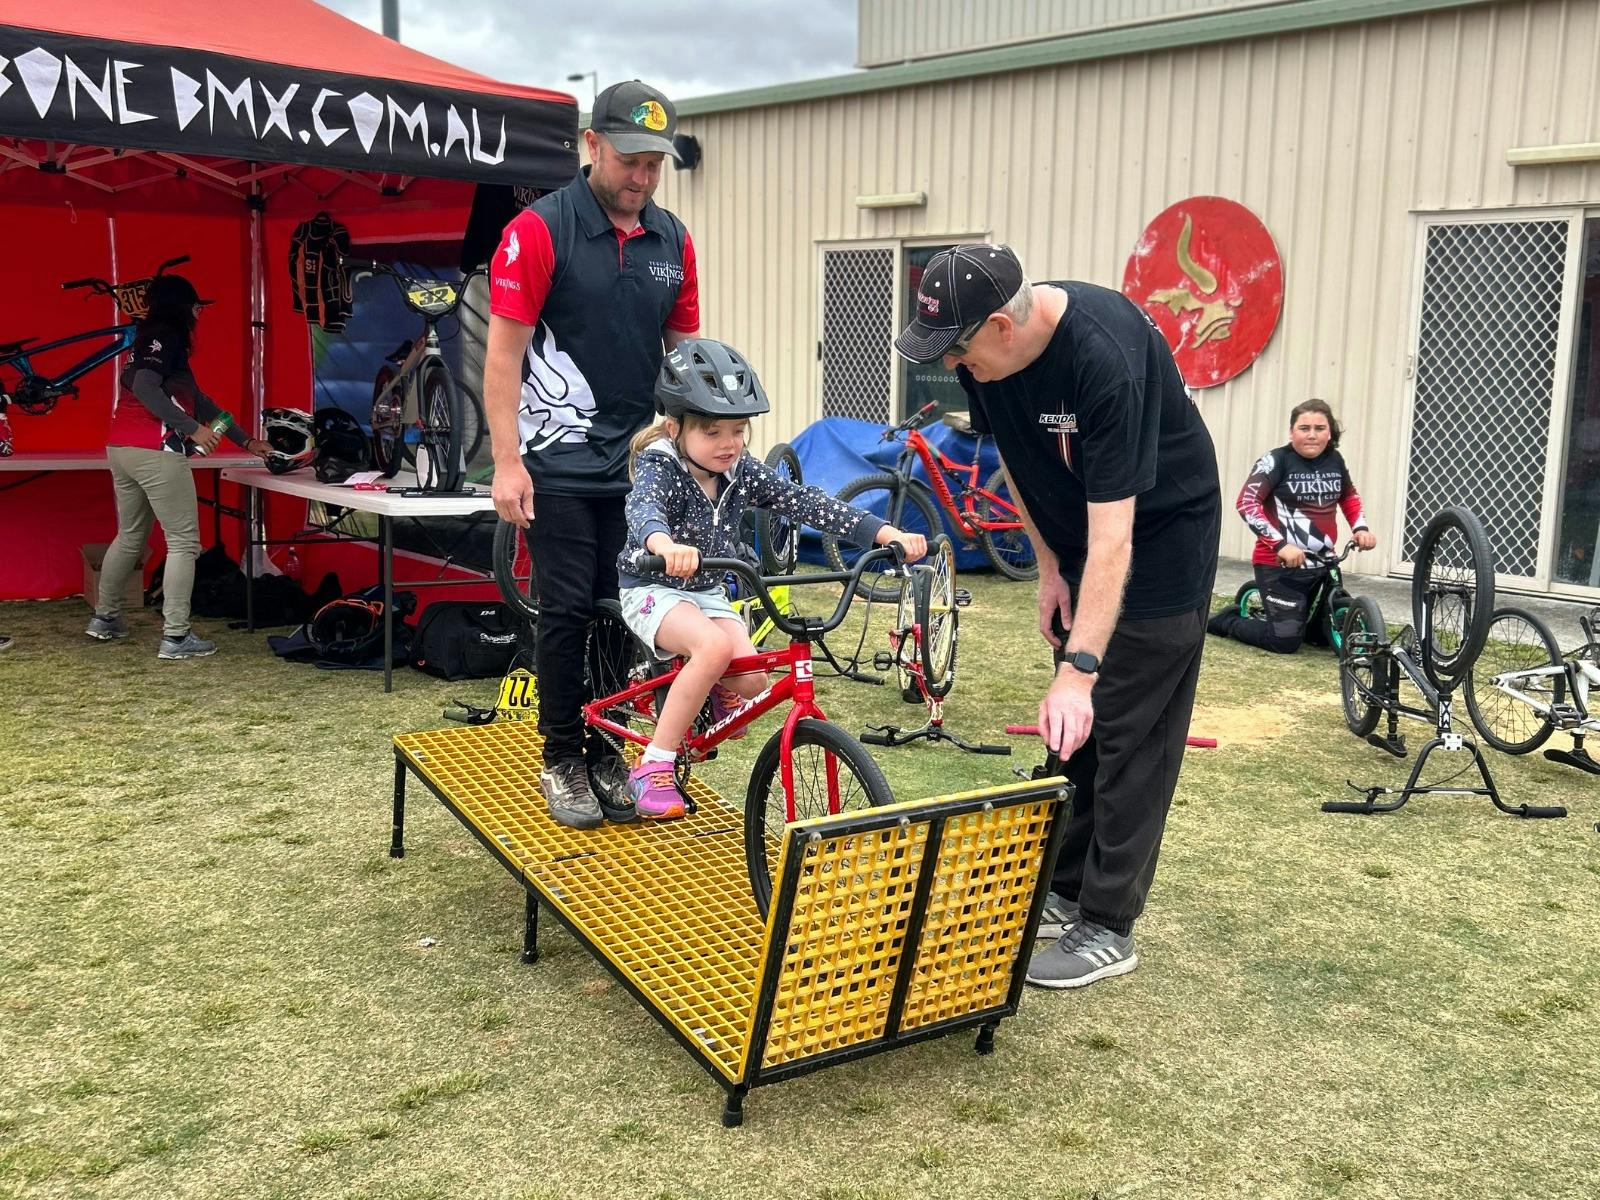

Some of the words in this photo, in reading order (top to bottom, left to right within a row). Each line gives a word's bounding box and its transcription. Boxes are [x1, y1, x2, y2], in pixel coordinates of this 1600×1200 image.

[648, 265, 685, 281] VIKINGS
[495, 277, 520, 292] VIKINGS
[420, 288, 449, 306] 32
[1039, 413, 1077, 424] KENDA
[508, 676, 531, 707] 22
